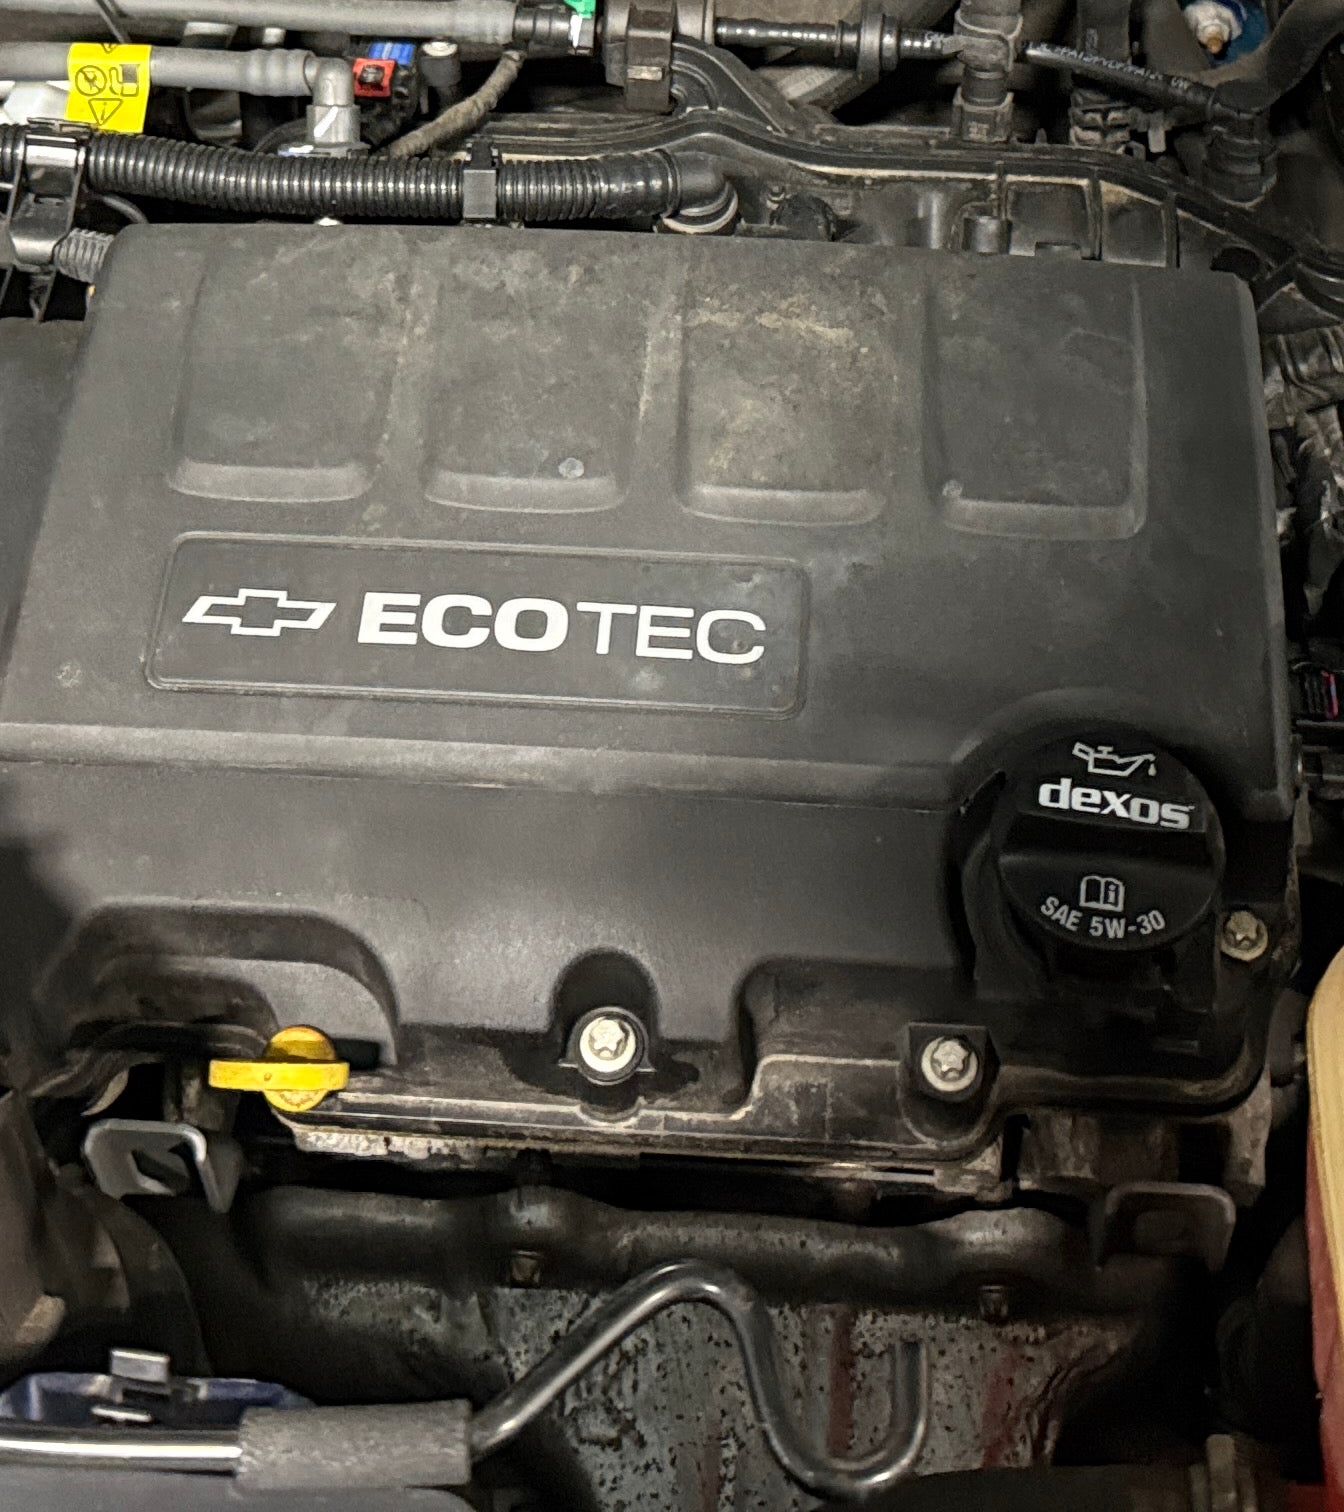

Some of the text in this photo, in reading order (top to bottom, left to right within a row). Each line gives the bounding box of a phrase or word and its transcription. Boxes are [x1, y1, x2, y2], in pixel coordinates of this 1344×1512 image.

[357, 592, 766, 666] ECOTEC
[1038, 778, 1193, 830] dexos
[1040, 896, 1167, 940] SAE 5W-30
